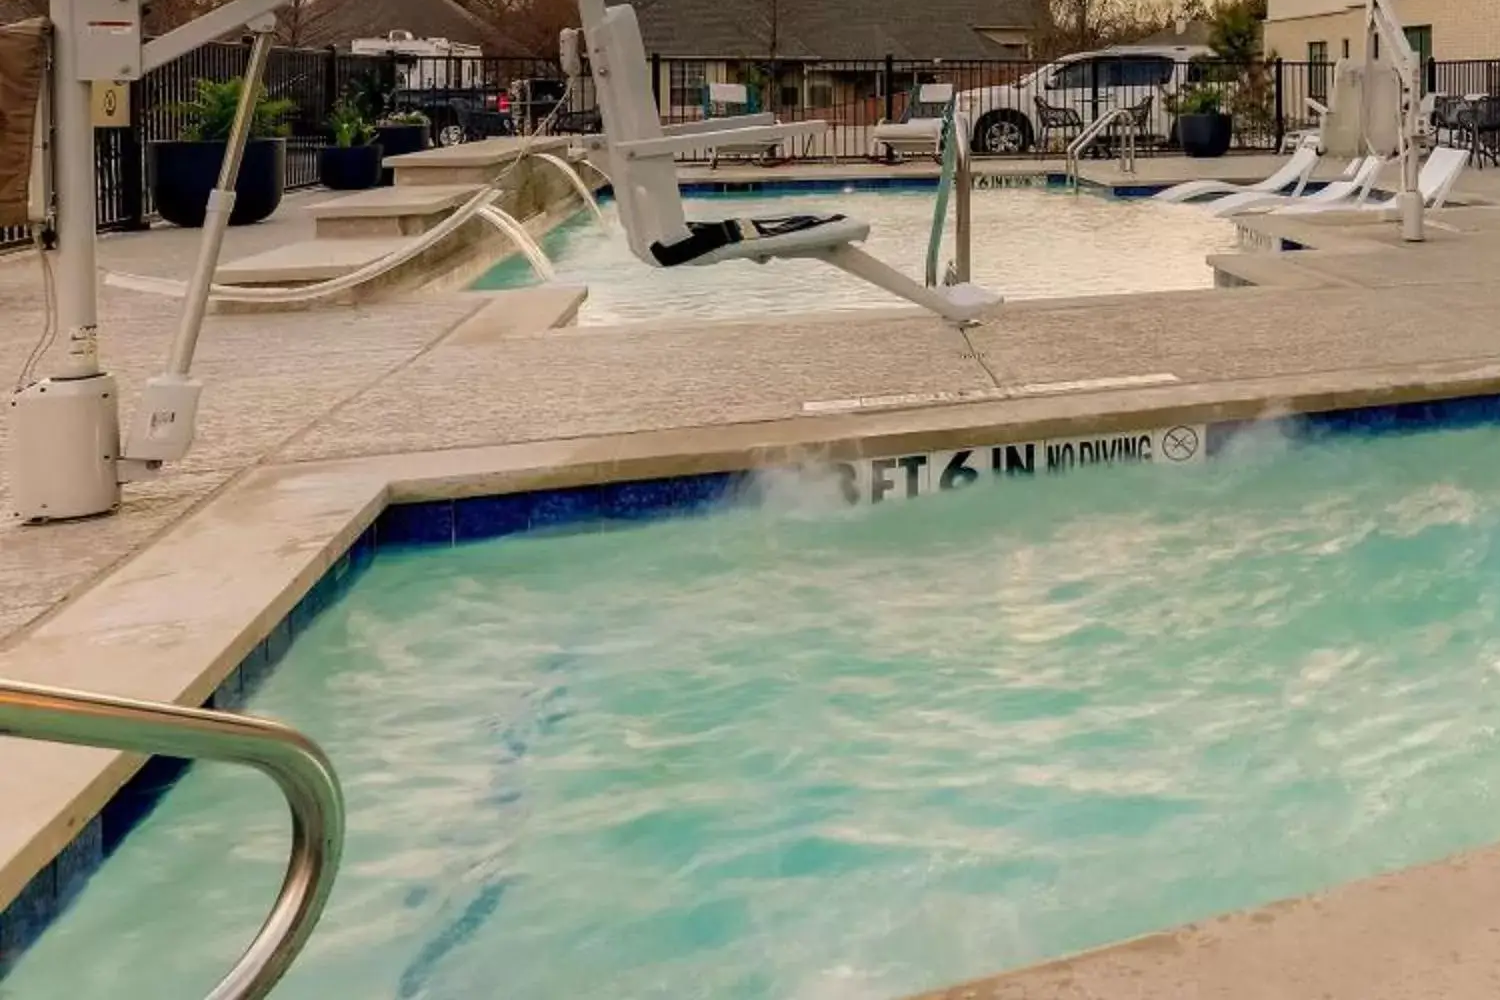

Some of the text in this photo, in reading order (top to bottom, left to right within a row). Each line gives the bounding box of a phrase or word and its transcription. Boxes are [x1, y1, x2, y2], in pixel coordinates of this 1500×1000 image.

[871, 455, 928, 506] FT
[939, 449, 979, 492] 6
[992, 443, 1036, 477] IN
[1079, 434, 1153, 468] DIVING
